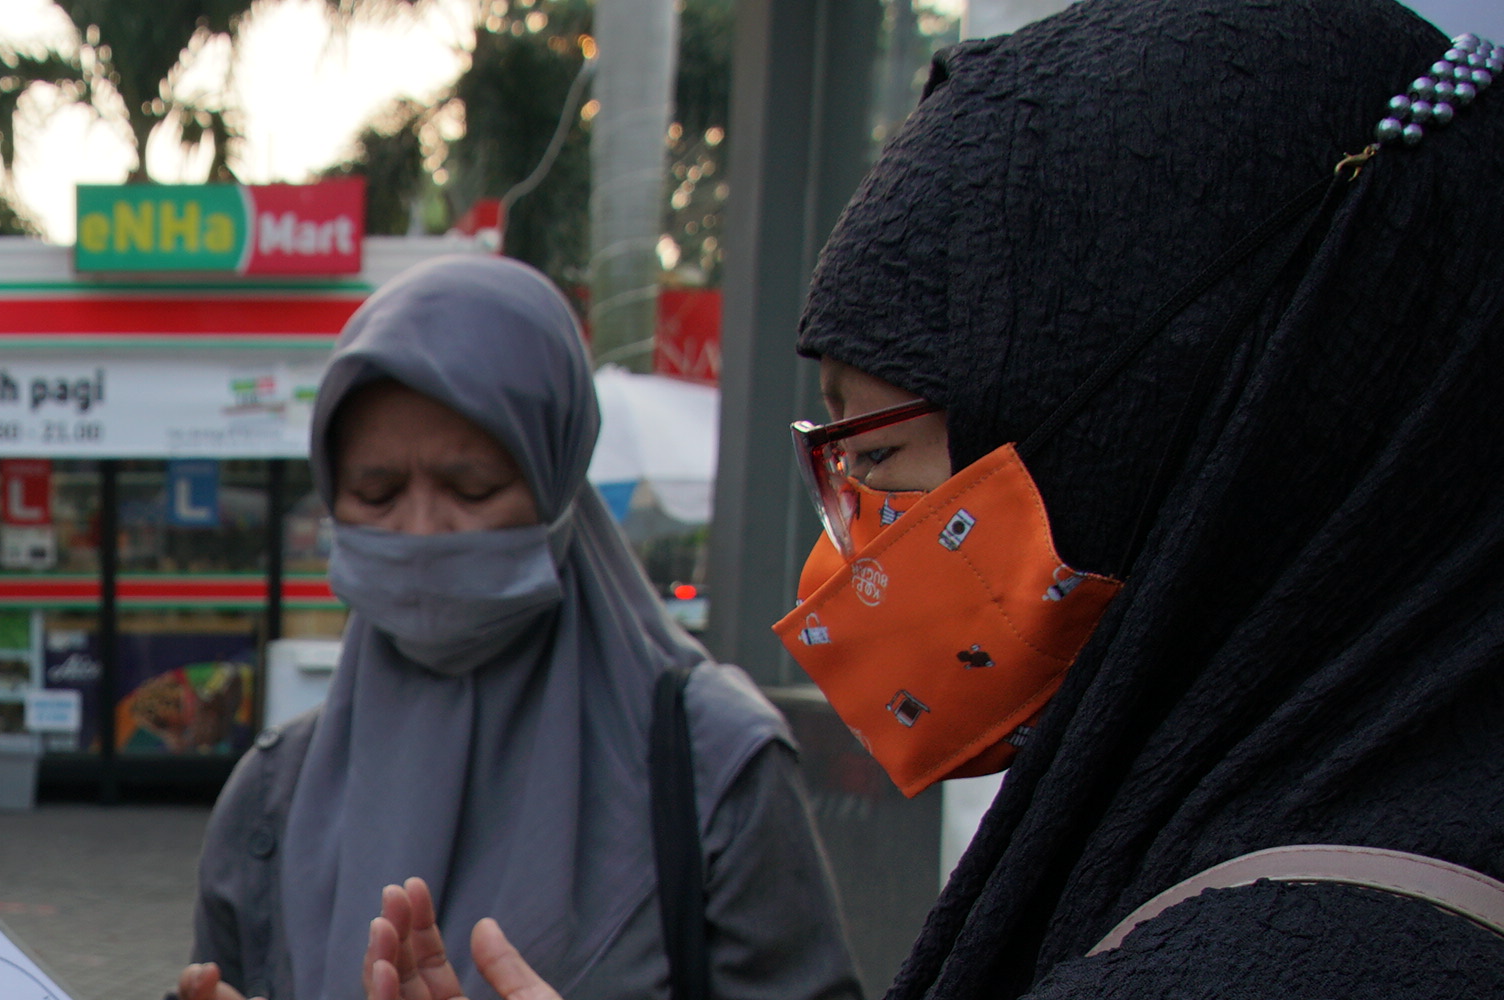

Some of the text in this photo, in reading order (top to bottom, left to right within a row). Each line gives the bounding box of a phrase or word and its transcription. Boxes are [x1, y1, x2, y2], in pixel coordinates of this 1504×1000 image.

[80, 202, 354, 254] eNHa Mart
[30, 367, 105, 412] pagi
